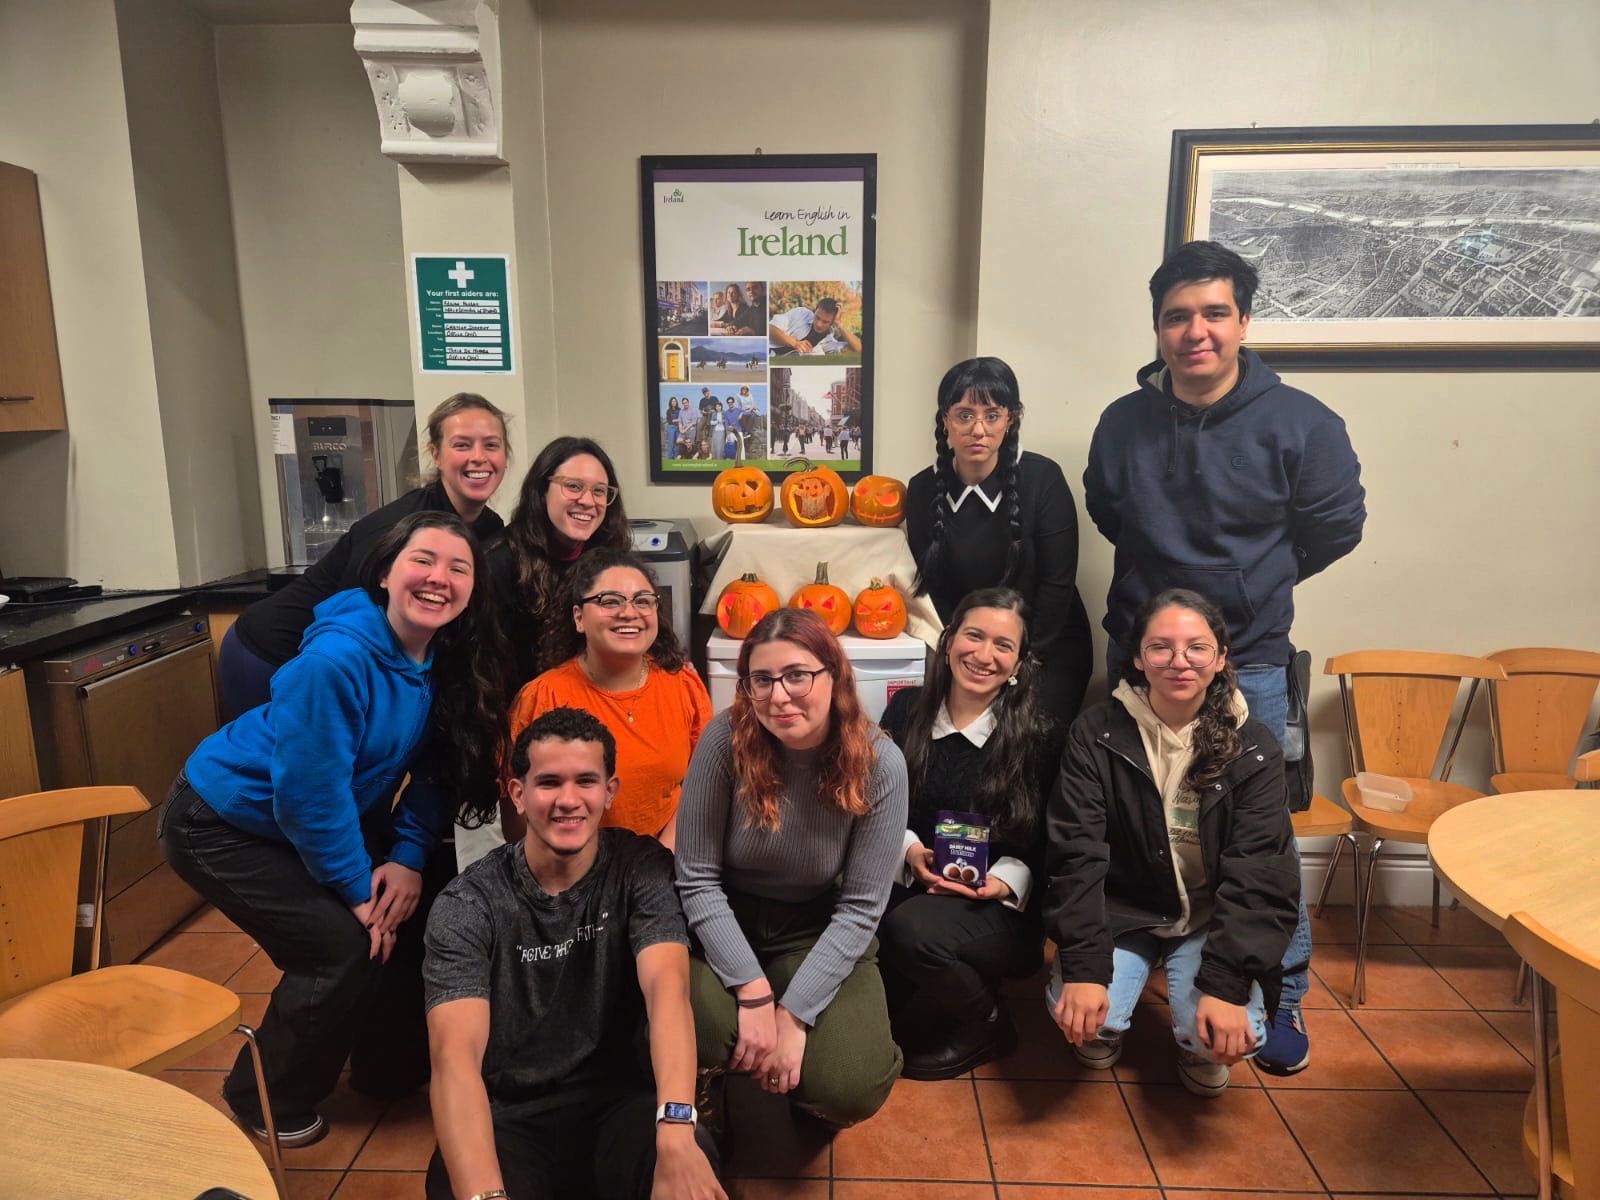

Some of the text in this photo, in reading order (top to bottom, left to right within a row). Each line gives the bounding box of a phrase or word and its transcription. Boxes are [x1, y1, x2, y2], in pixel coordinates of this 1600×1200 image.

[764, 205, 850, 226] Learn English in
[737, 225, 849, 257] Ireland
